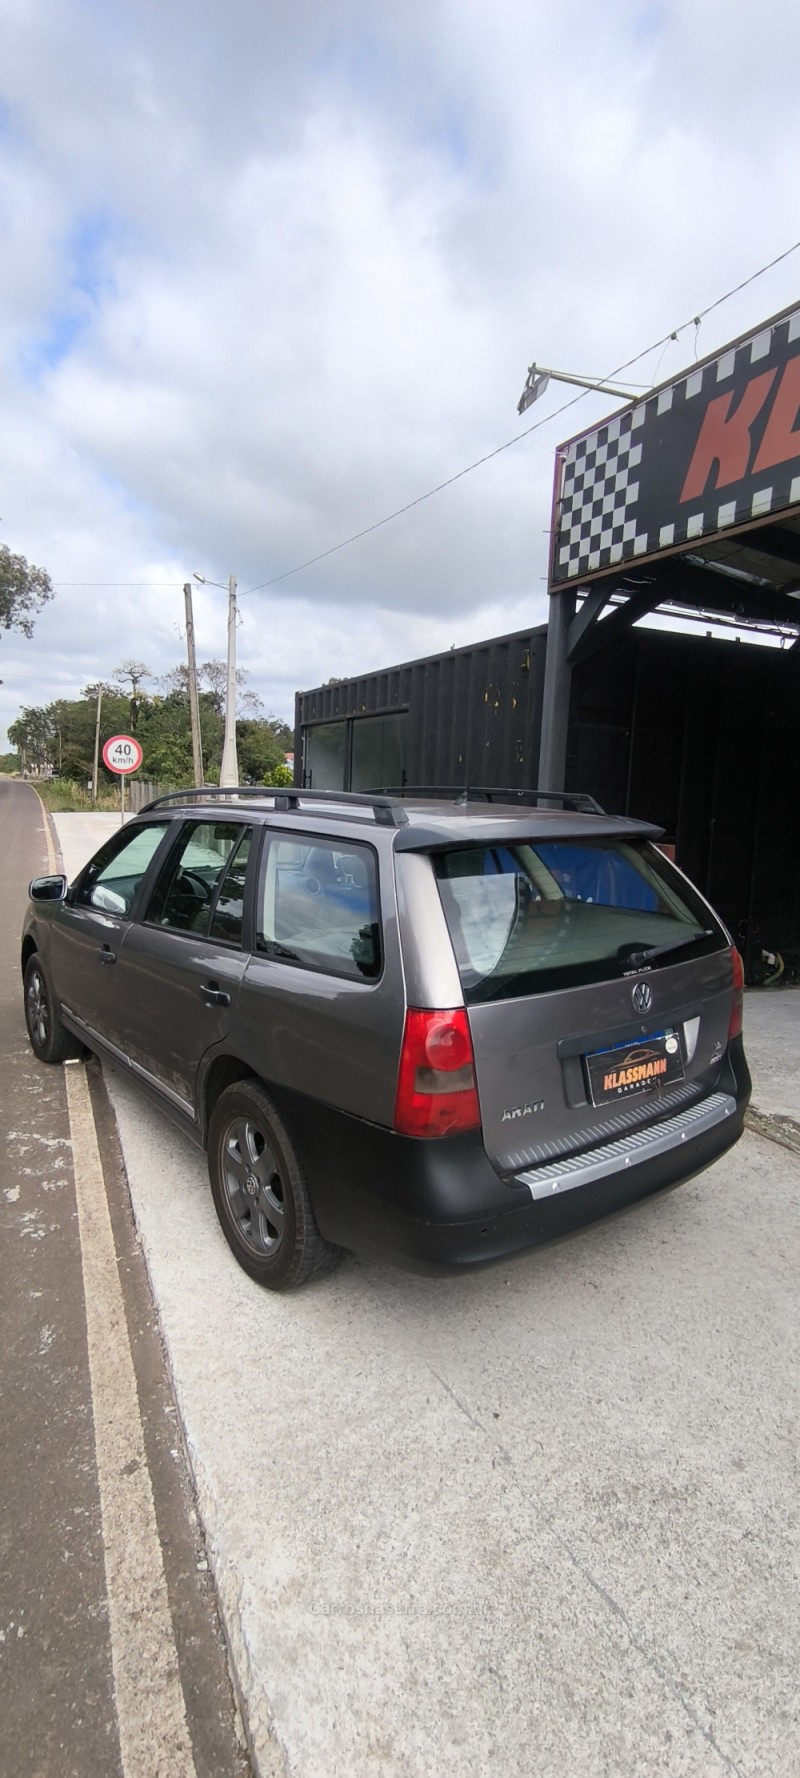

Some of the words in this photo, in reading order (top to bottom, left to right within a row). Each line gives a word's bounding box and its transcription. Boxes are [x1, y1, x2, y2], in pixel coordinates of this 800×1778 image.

[114, 744, 131, 756] 40
[112, 756, 134, 764] km/h
[622, 969, 638, 977] TOTAL
[604, 1058, 667, 1091] KLASSMANN
